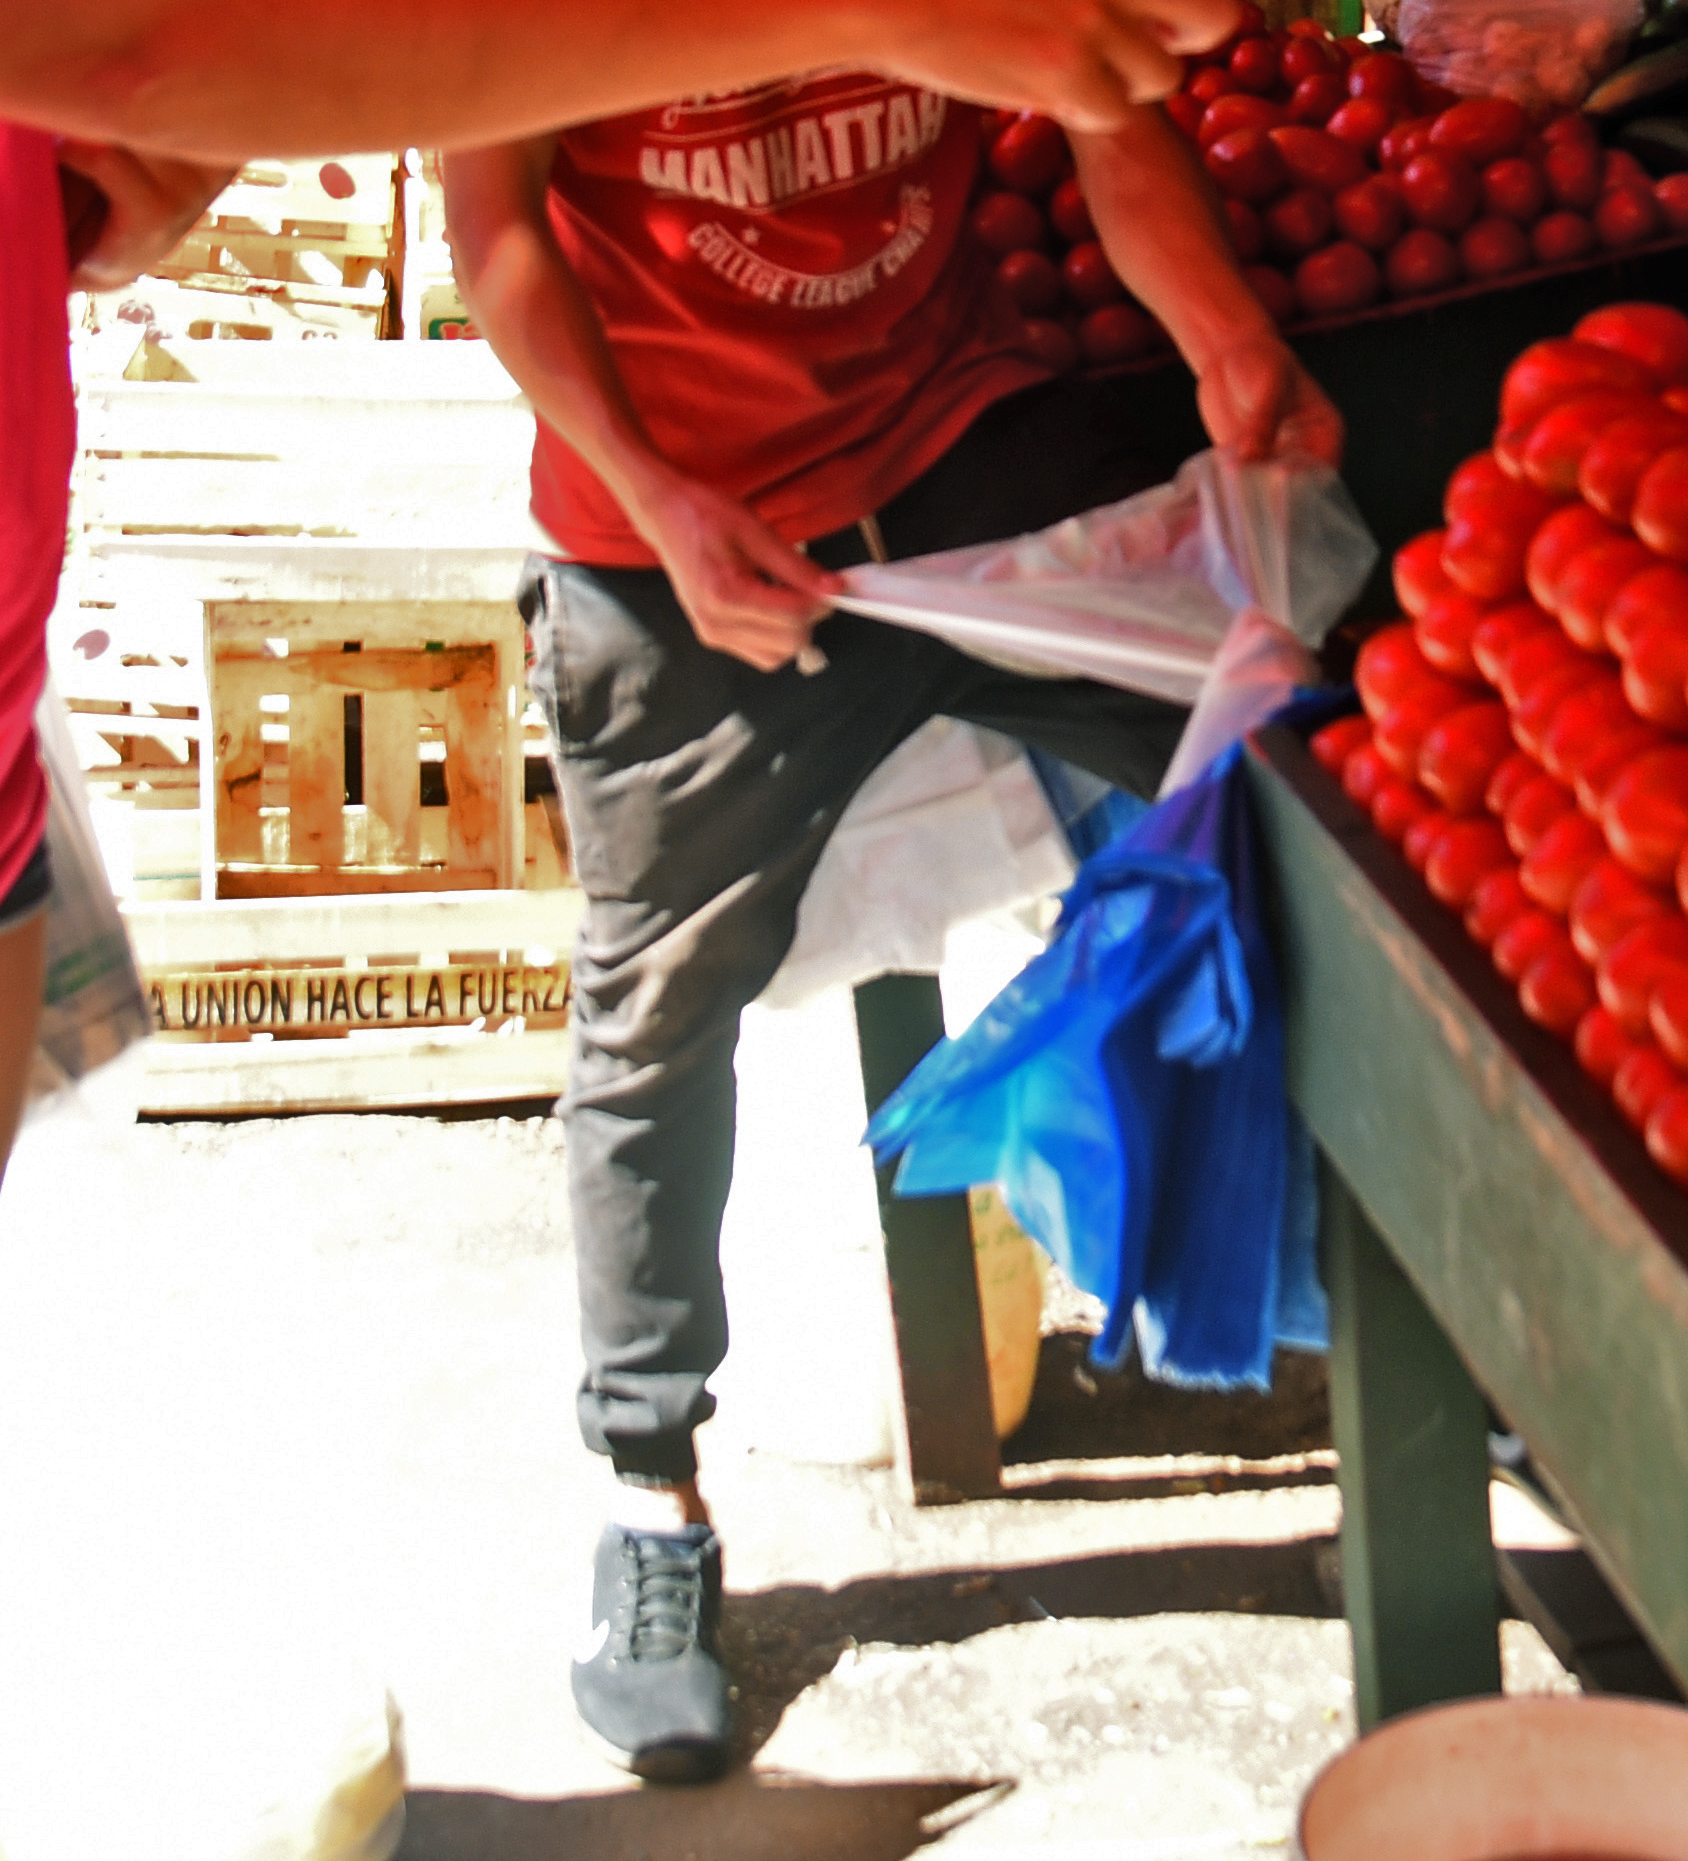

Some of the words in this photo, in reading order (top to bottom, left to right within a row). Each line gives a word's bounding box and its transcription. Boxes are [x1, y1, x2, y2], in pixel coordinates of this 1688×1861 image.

[688, 221, 788, 305] COLLEGE
[180, 976, 292, 1029] UNION
[307, 974, 393, 1024] HACE
[406, 972, 445, 1018] LA
